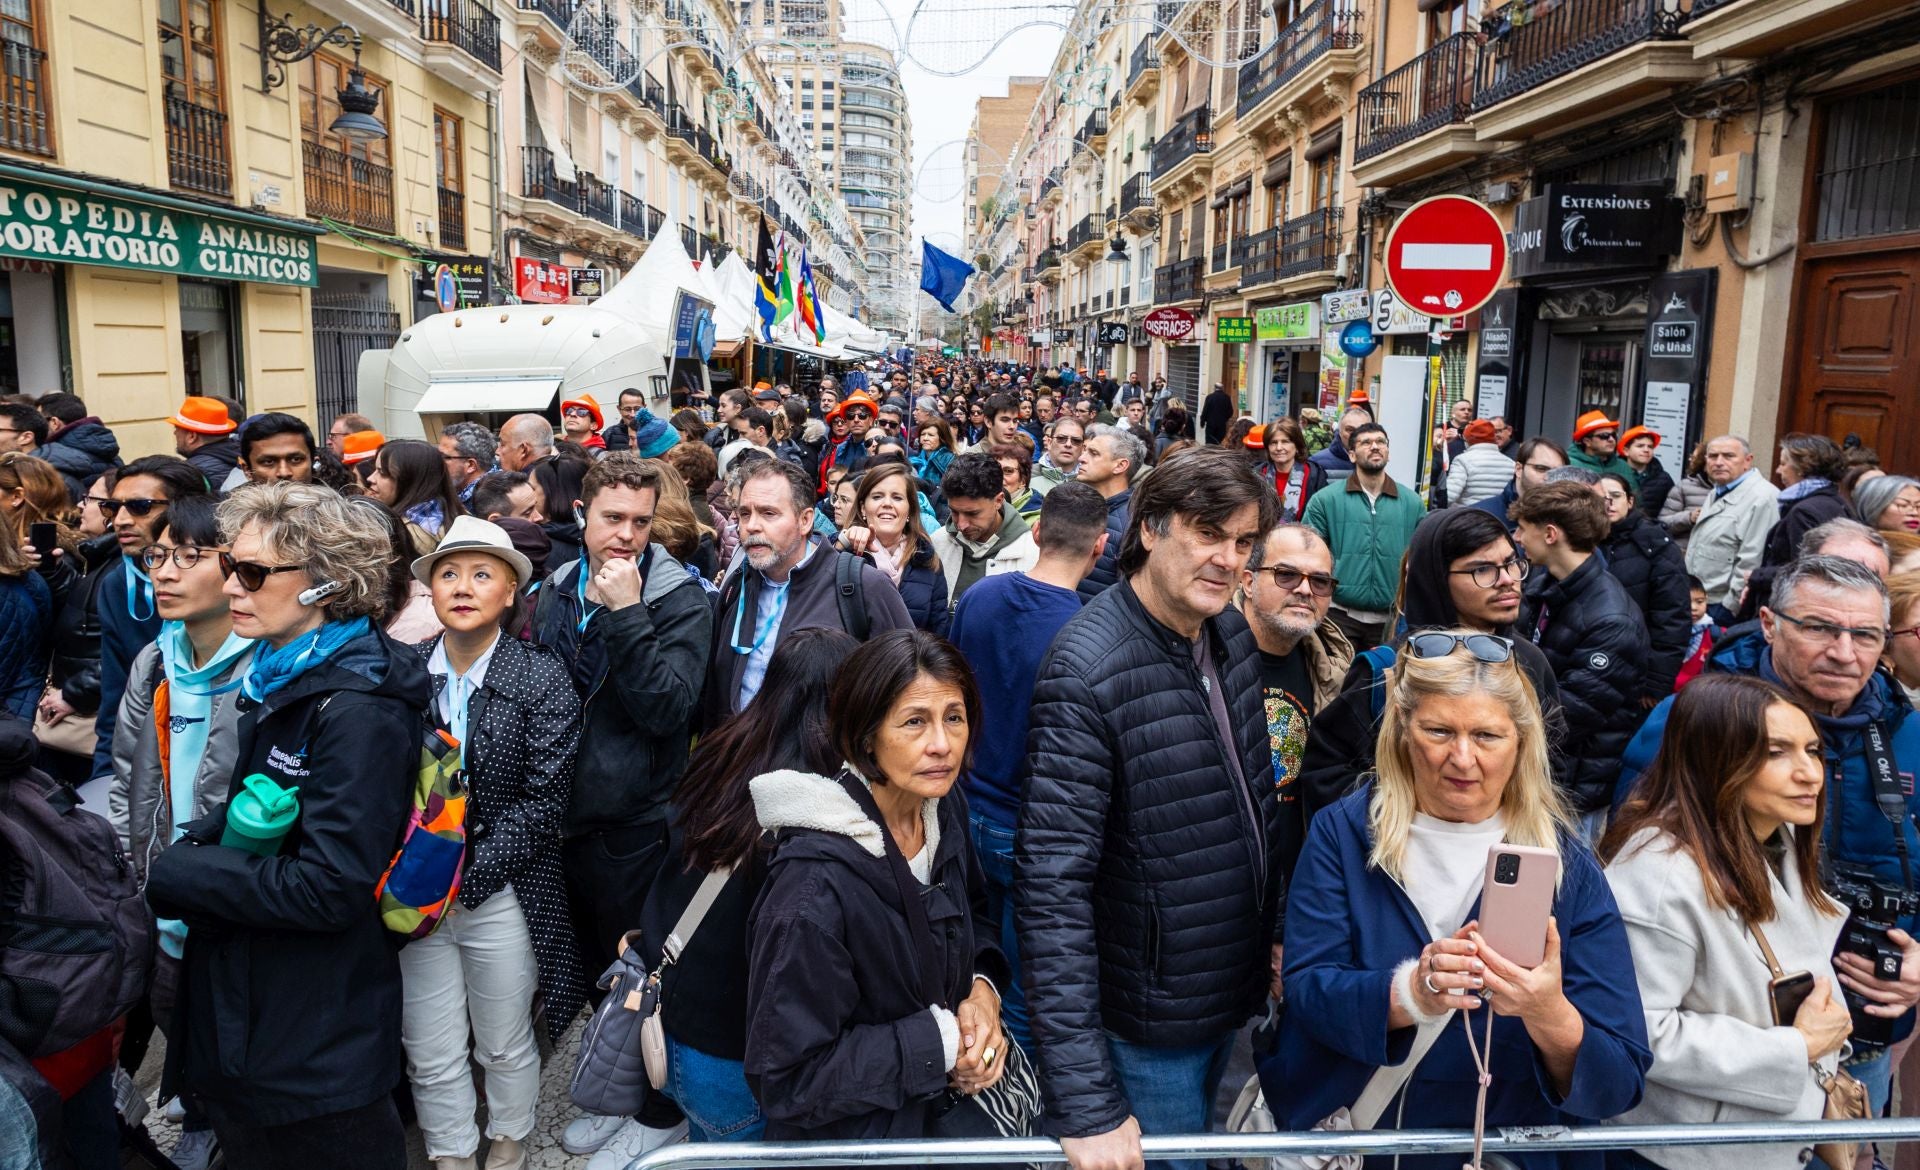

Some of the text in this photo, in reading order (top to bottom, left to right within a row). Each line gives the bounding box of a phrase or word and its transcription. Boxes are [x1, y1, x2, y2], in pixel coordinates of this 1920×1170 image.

[0, 221, 180, 267] ORATORIO
[198, 222, 310, 260] ANALISIS
[199, 248, 312, 282] CLINICOS
[1145, 320, 1192, 337] DISFRACES
[1658, 326, 1686, 337] Salón
[1344, 336, 1376, 344] DIGI
[1485, 332, 1508, 341] Alisado
[1483, 343, 1508, 352] Japones
[1653, 341, 1692, 352] de Uñas
[1869, 724, 1893, 782] TEM OM-1
